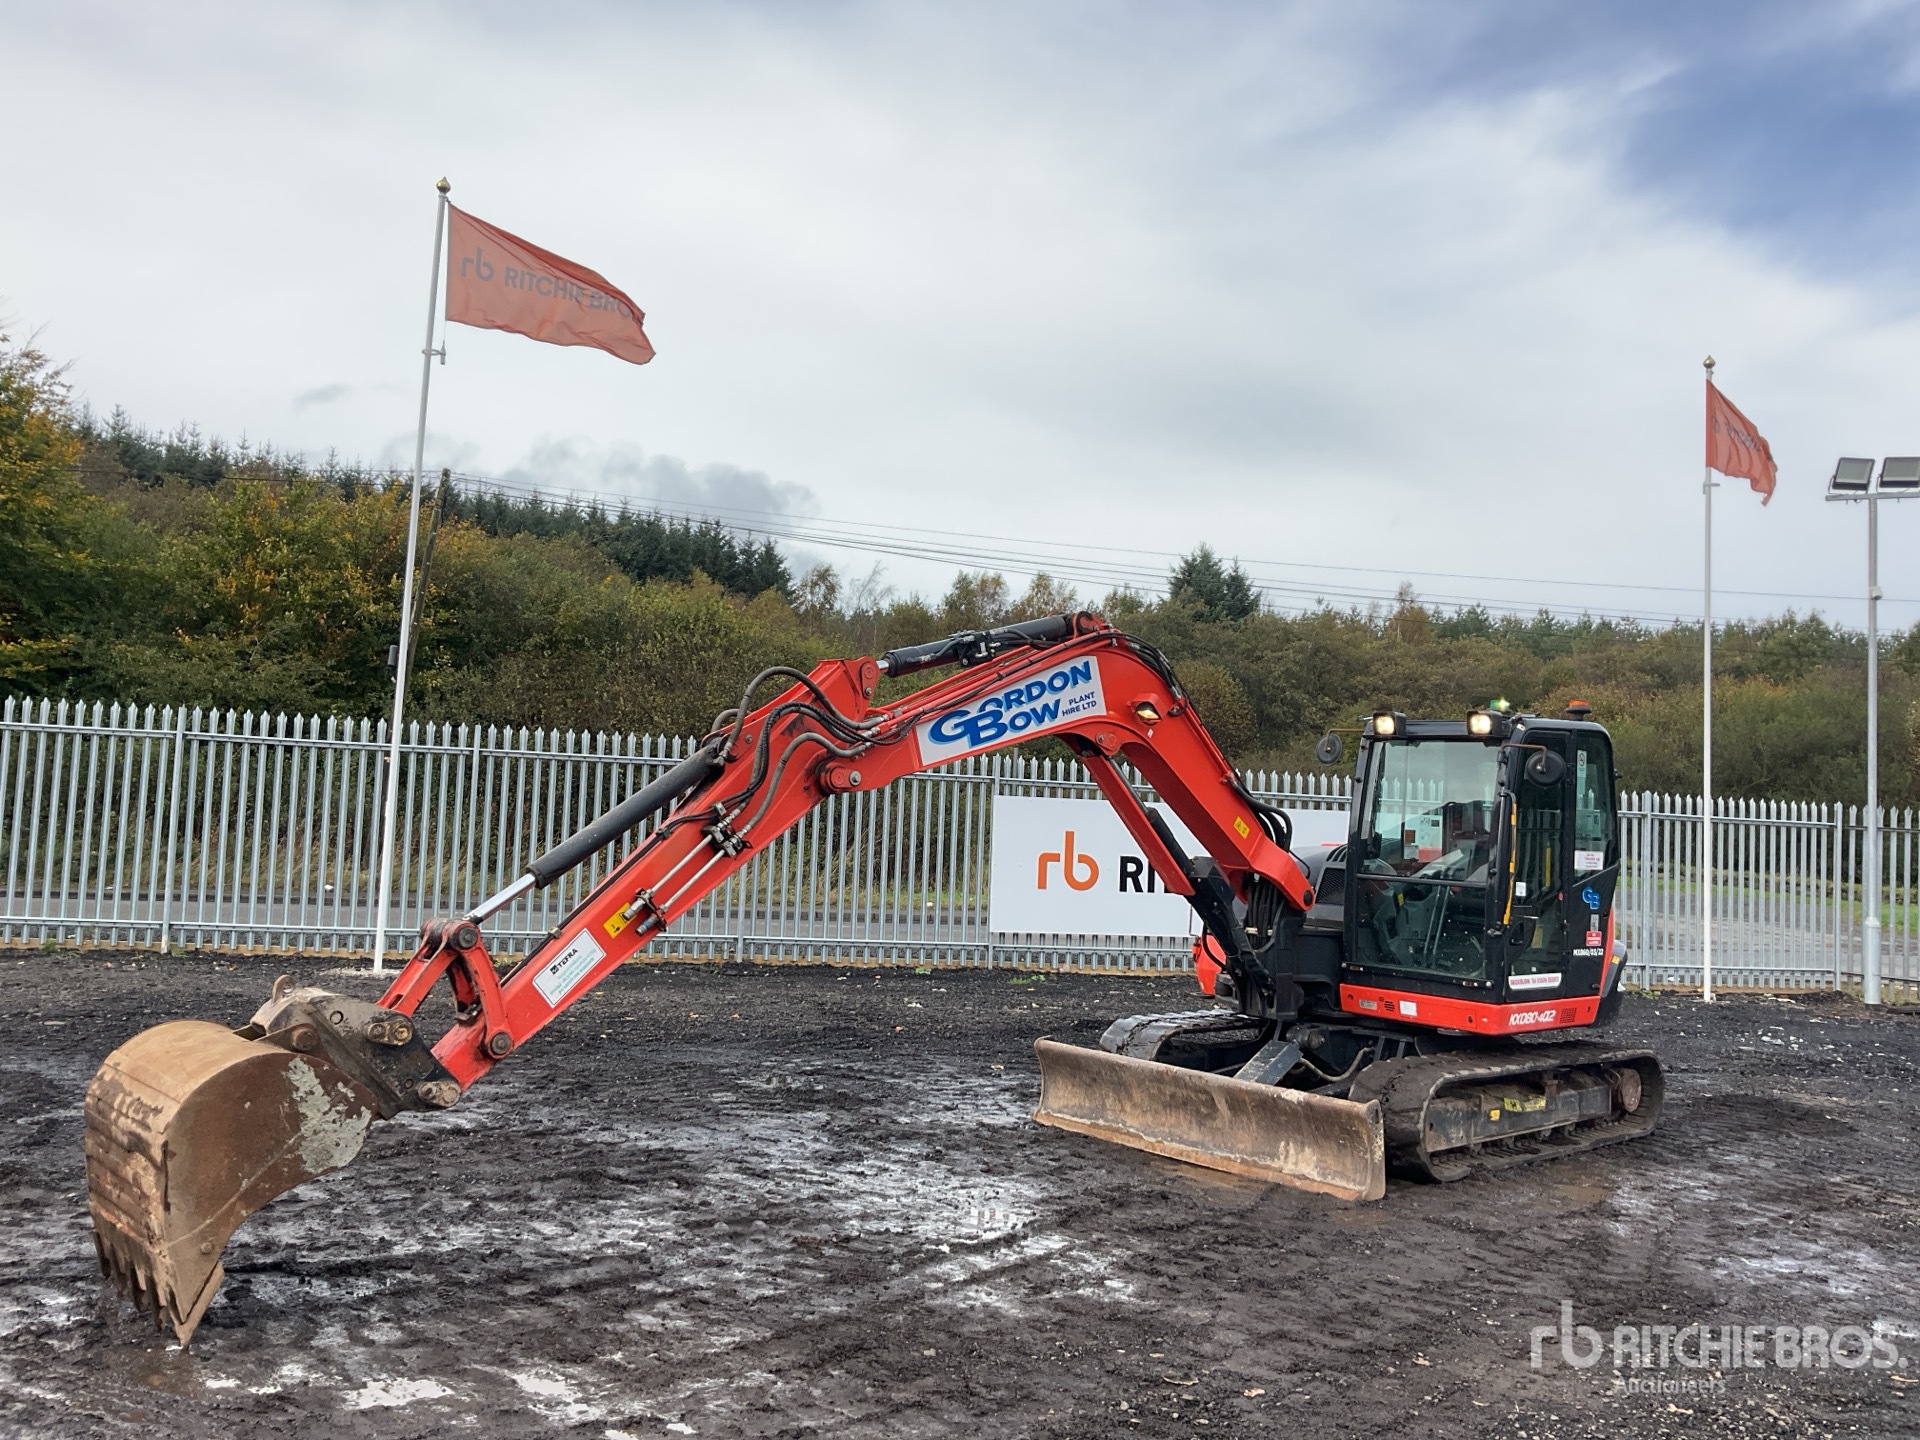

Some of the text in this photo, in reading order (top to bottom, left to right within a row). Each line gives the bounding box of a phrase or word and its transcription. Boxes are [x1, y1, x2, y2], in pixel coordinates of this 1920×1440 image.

[460, 247, 495, 282] rb
[588, 291, 634, 319] BRO
[928, 660, 1092, 745] GORDON
[967, 698, 1061, 749] BOW
[1062, 700, 1097, 717] HIRE LTD
[1069, 691, 1095, 706] PLANT
[1037, 830, 1173, 893] rb RI
